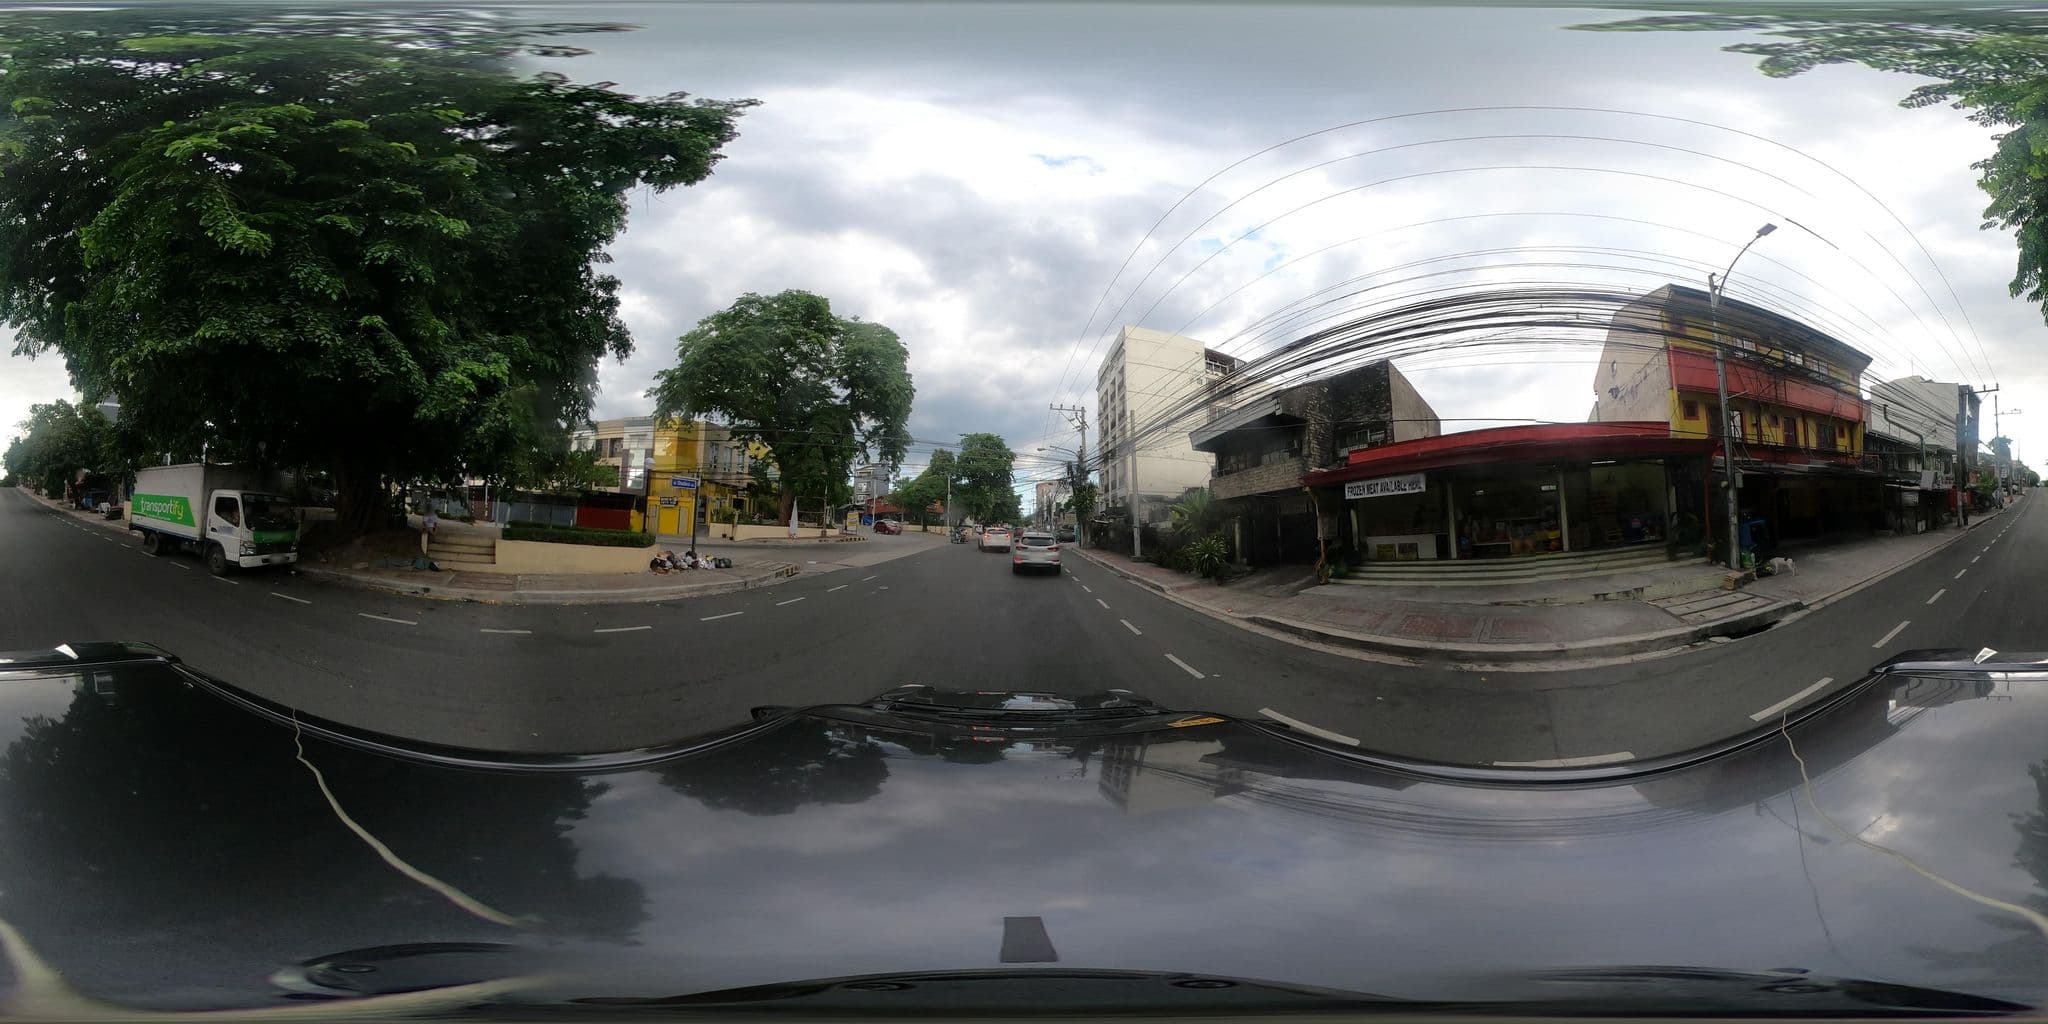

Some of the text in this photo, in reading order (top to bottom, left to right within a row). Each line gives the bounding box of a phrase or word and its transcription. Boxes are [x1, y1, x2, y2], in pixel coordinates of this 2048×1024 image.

[1347, 485, 1366, 497] FROZEN
[1366, 482, 1379, 495] MEAT
[1380, 479, 1407, 492] AVAILABLE
[141, 498, 183, 520] transportify
